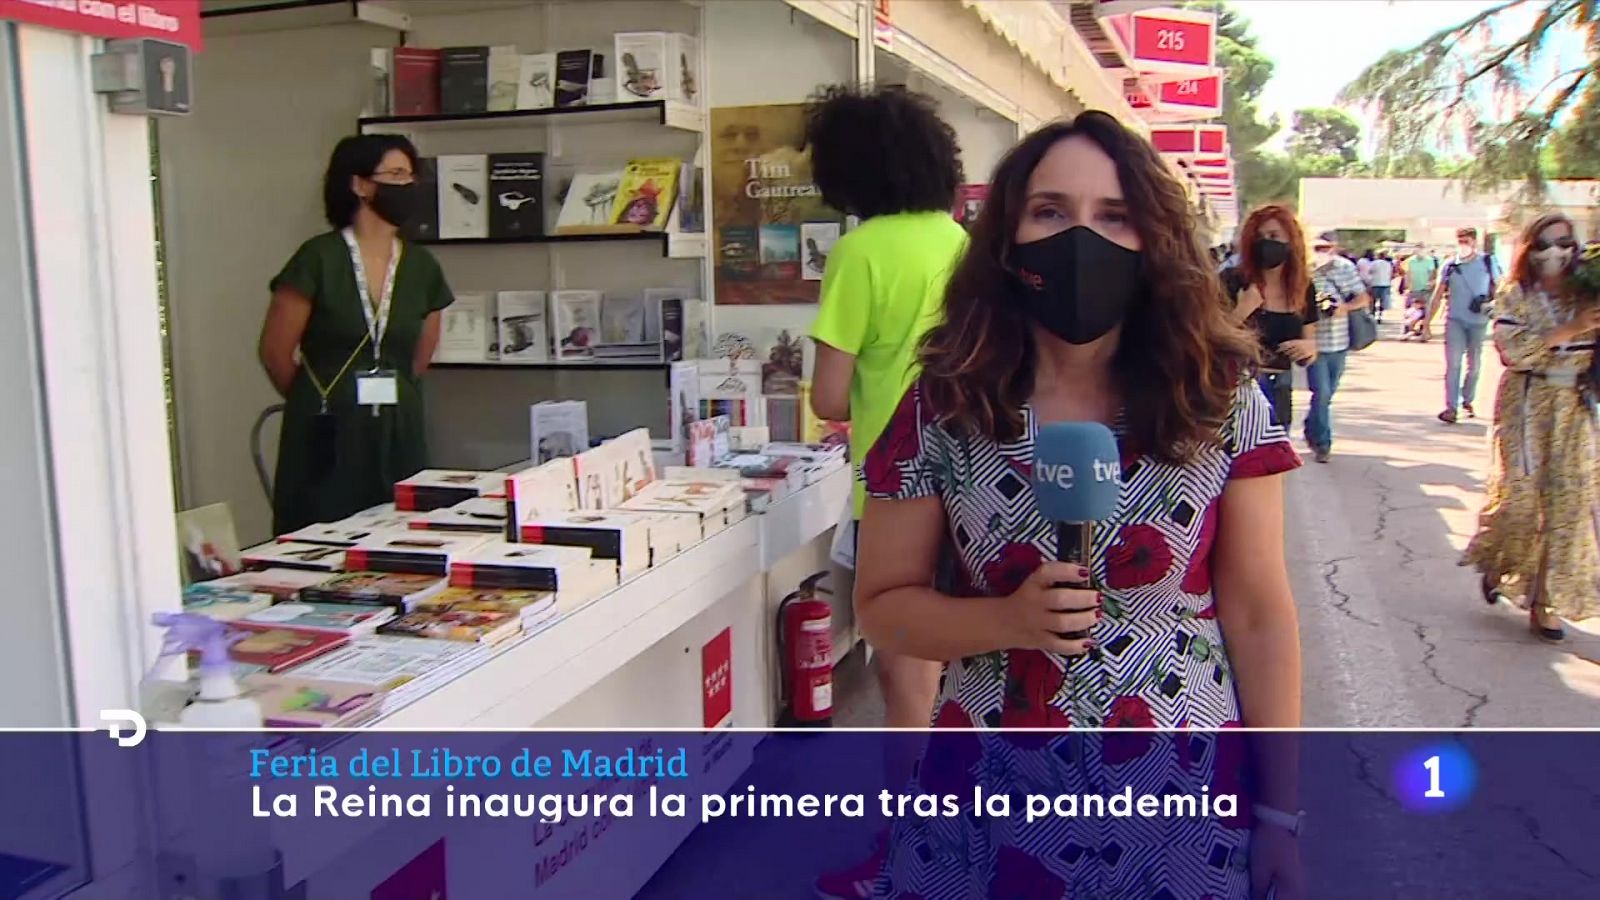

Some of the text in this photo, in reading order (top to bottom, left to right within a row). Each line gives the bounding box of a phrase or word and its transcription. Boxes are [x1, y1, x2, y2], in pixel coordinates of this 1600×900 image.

[78, 0, 117, 20] con
[117, 3, 138, 25] el
[1157, 29, 1185, 51] 215
[1176, 79, 1199, 95] 214
[744, 157, 791, 178] Tim
[745, 180, 822, 199] Gautrea
[1035, 458, 1074, 489] tve
[1093, 458, 1121, 485] tve
